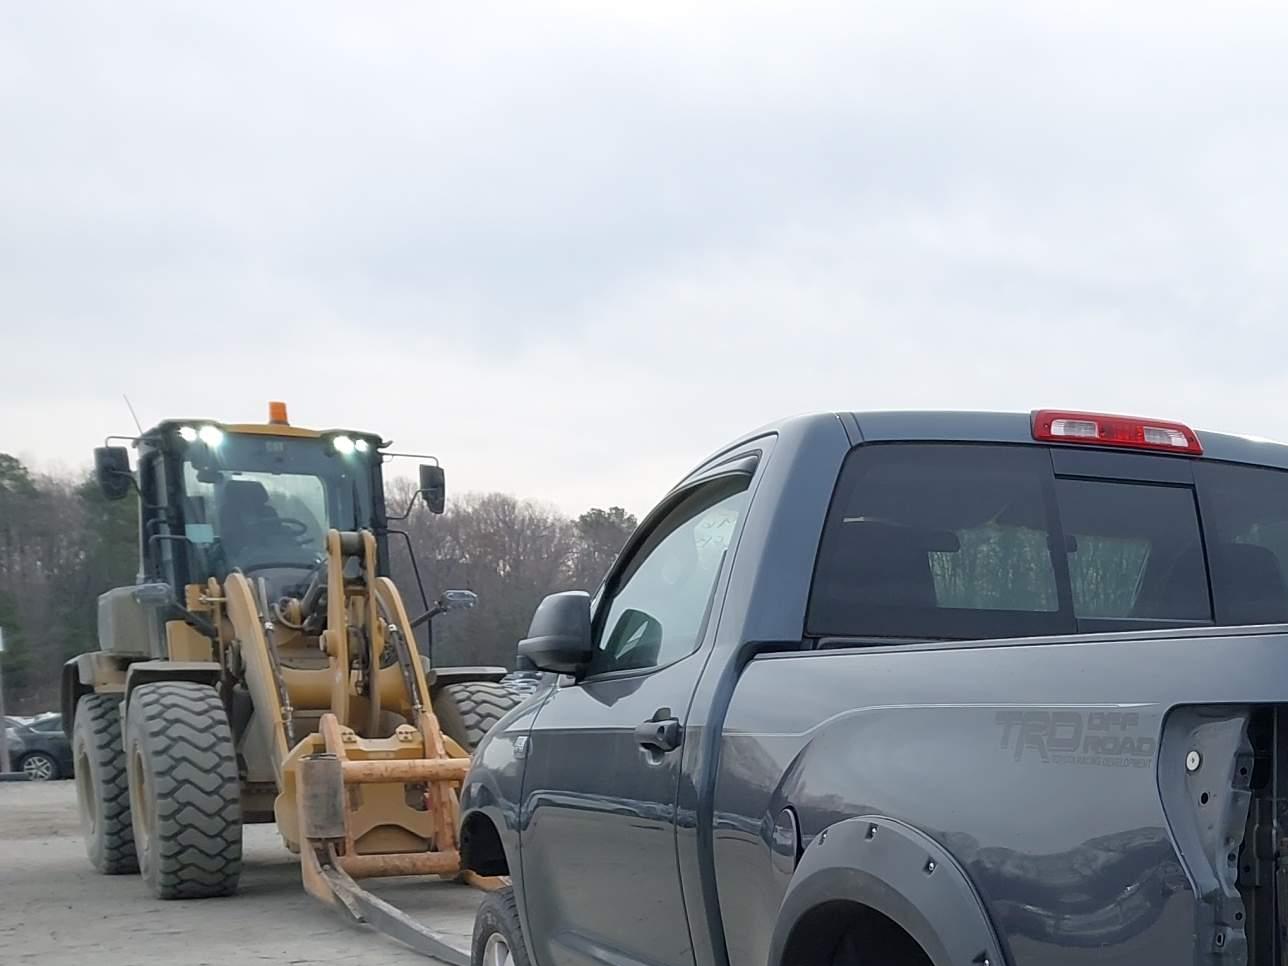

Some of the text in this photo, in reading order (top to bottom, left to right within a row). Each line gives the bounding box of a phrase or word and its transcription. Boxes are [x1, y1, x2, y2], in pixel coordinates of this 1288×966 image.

[1088, 711, 1139, 731] OFF
[995, 711, 1084, 763] TRD
[1083, 736, 1155, 756] ROAD
